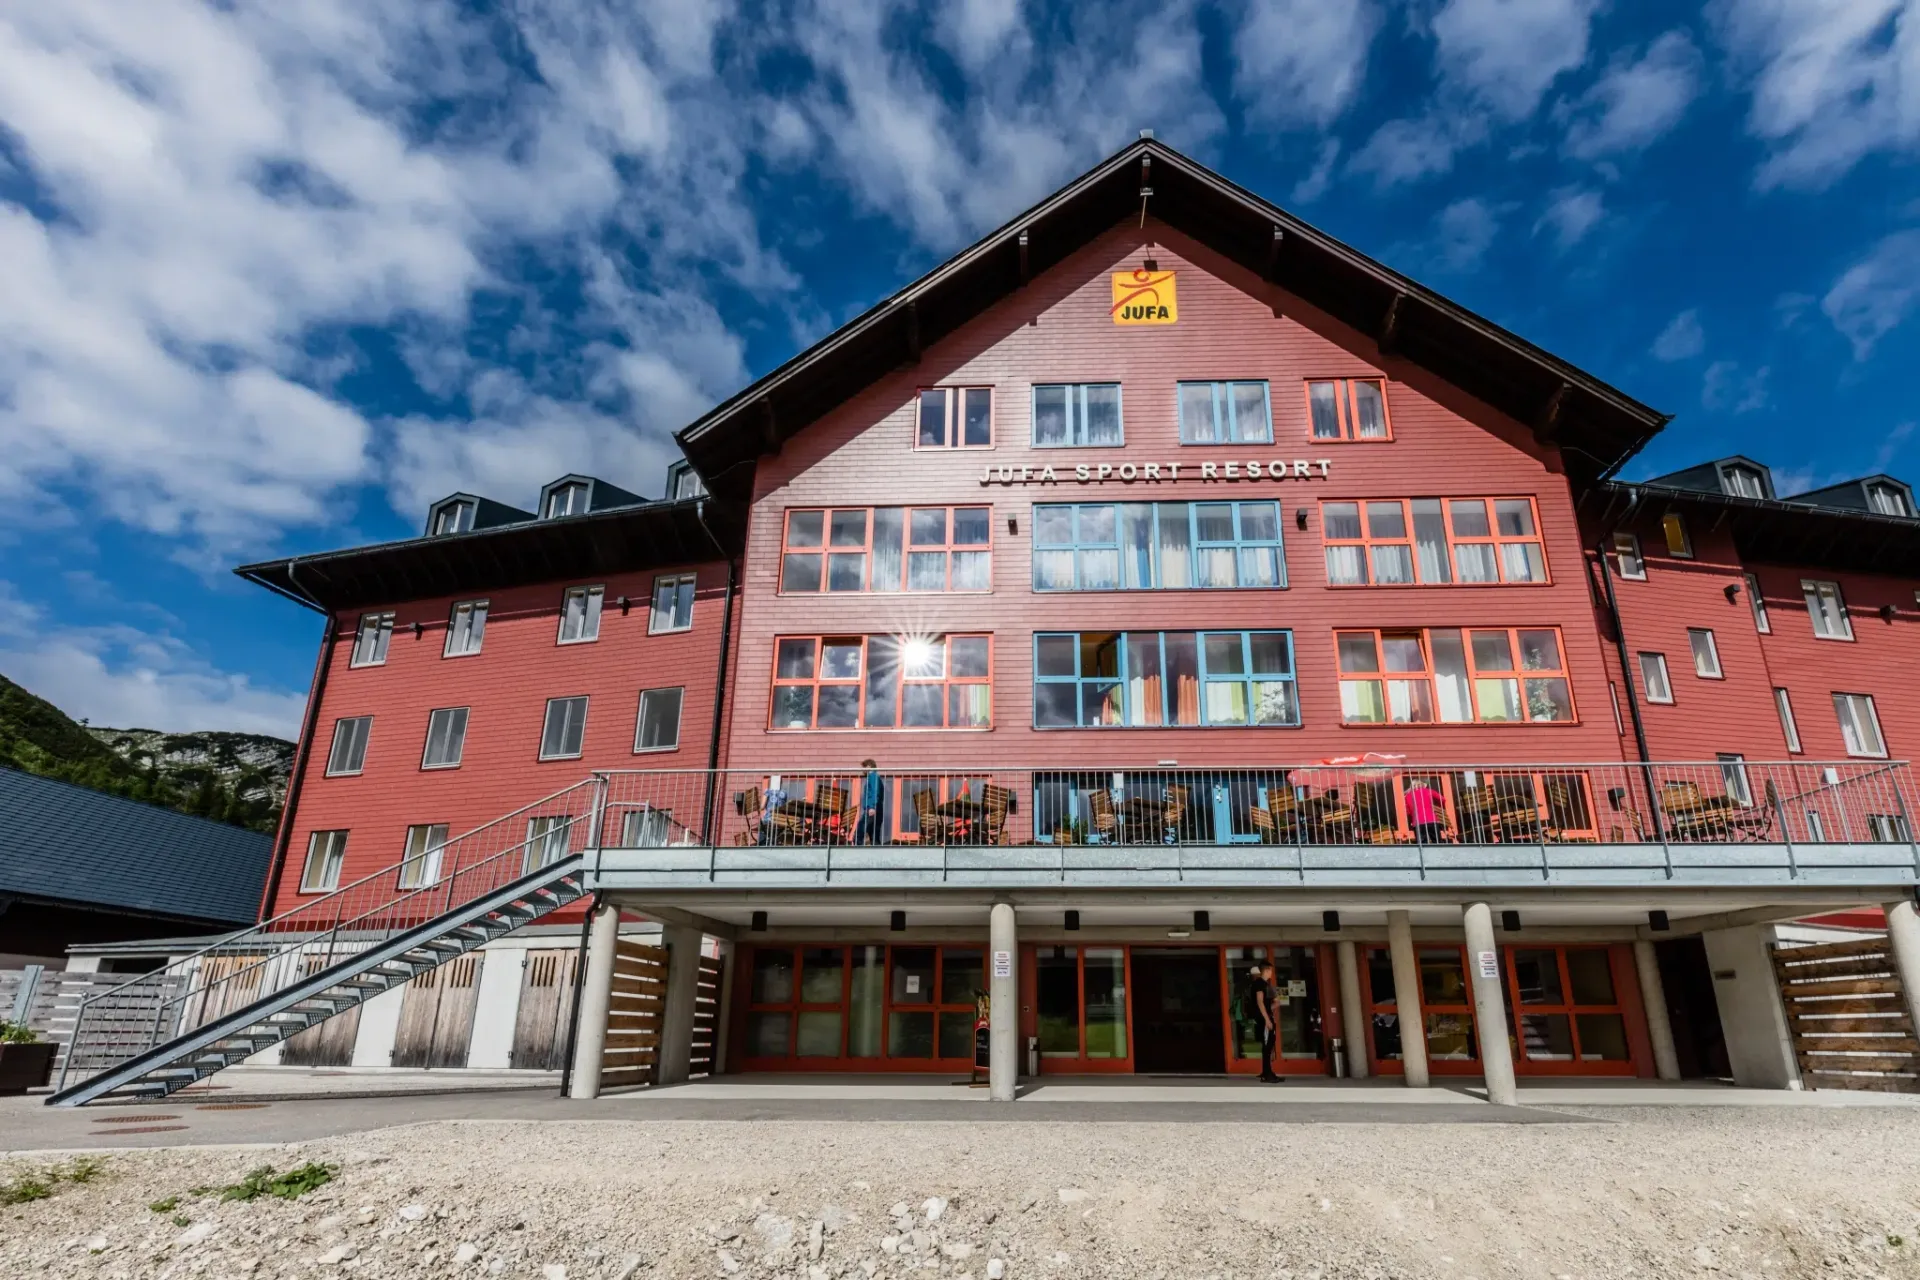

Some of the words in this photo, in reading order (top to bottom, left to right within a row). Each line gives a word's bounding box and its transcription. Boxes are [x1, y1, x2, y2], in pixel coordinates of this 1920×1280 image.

[1121, 305, 1169, 320] JUFA
[978, 464, 1057, 483] JUFA
[1075, 462, 1182, 481] SPORT
[1201, 459, 1332, 479] RESORT
